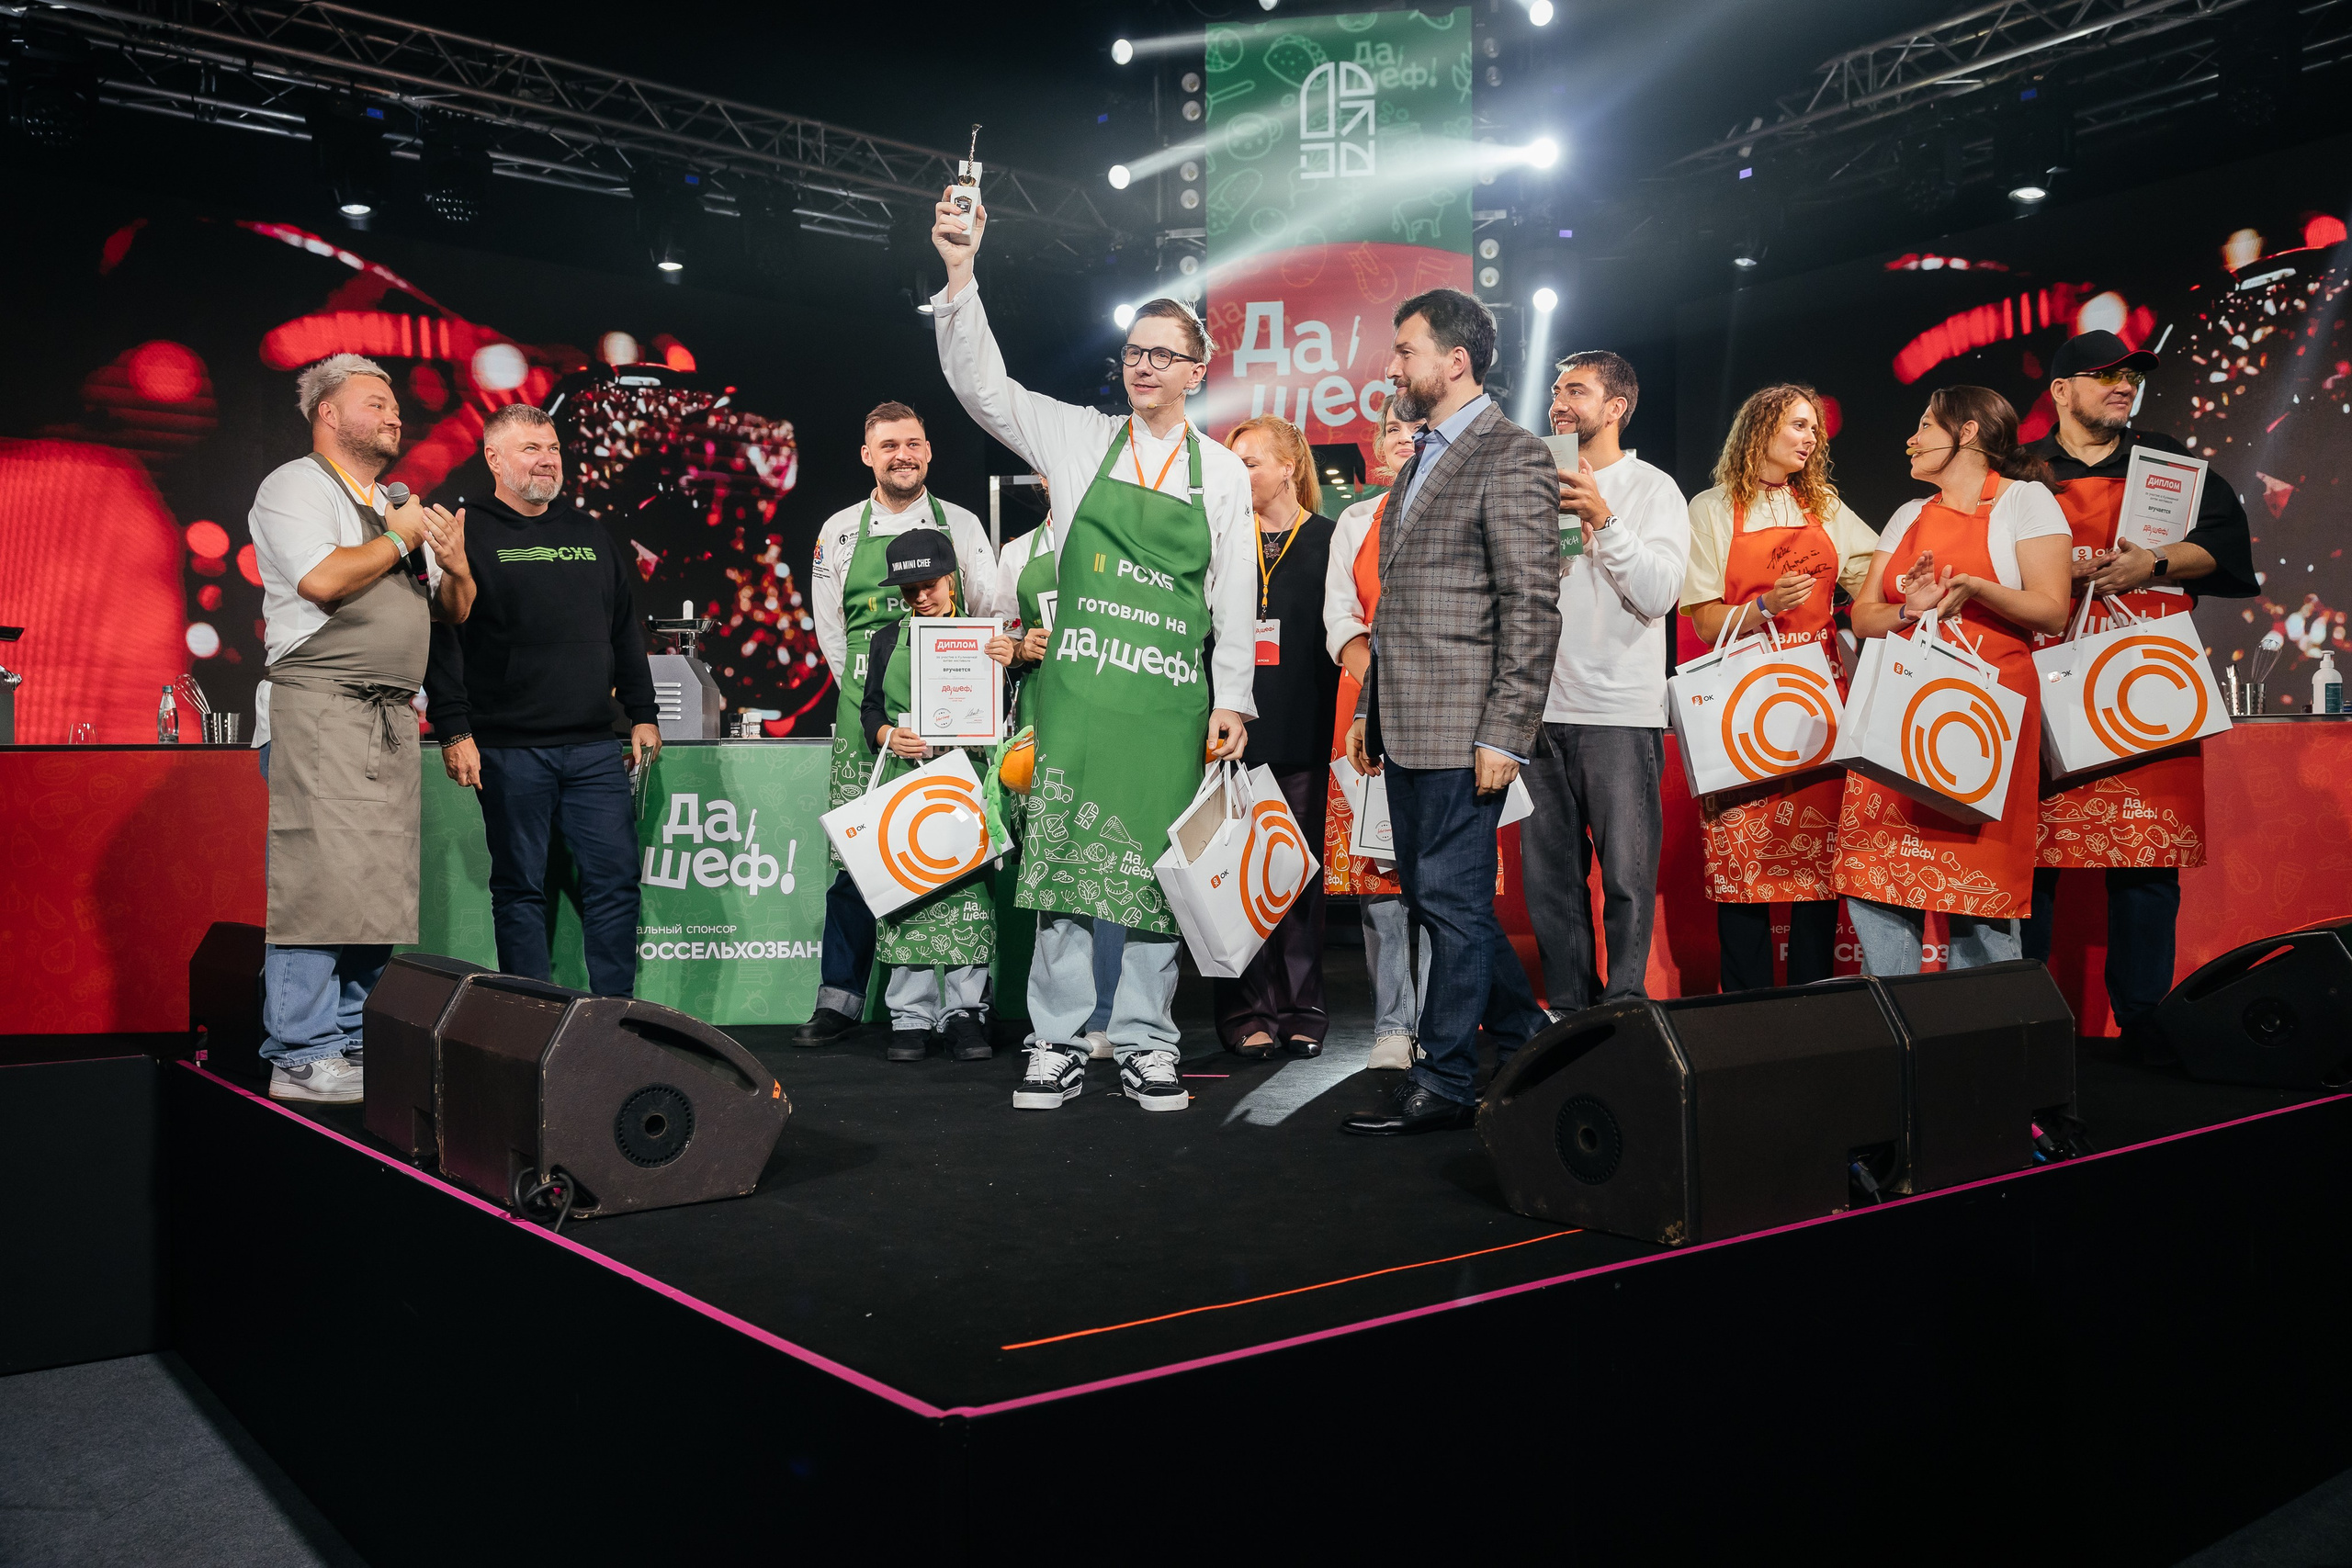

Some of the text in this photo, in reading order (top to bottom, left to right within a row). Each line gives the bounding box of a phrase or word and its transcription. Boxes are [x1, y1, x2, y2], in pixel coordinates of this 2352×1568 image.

[2148, 477, 2180, 491] ДИПЛОМ
[902, 559, 916, 570] MINI
[916, 558, 932, 569] CHEF
[1116, 558, 1175, 592] РСХБ
[1077, 597, 1188, 636] готовлю на
[937, 641, 977, 650] ДИПЛОМ
[2122, 807, 2158, 819] шеф!
[1900, 845, 1937, 861] шеф!
[640, 839, 797, 896] шеф!
[1119, 862, 1156, 882] шеф!
[1714, 881, 1738, 895] шеф!
[963, 908, 989, 921] шеф!
[686, 924, 737, 938] спонсор
[636, 941, 822, 960] ОССЕЛЬХОЗБАН
